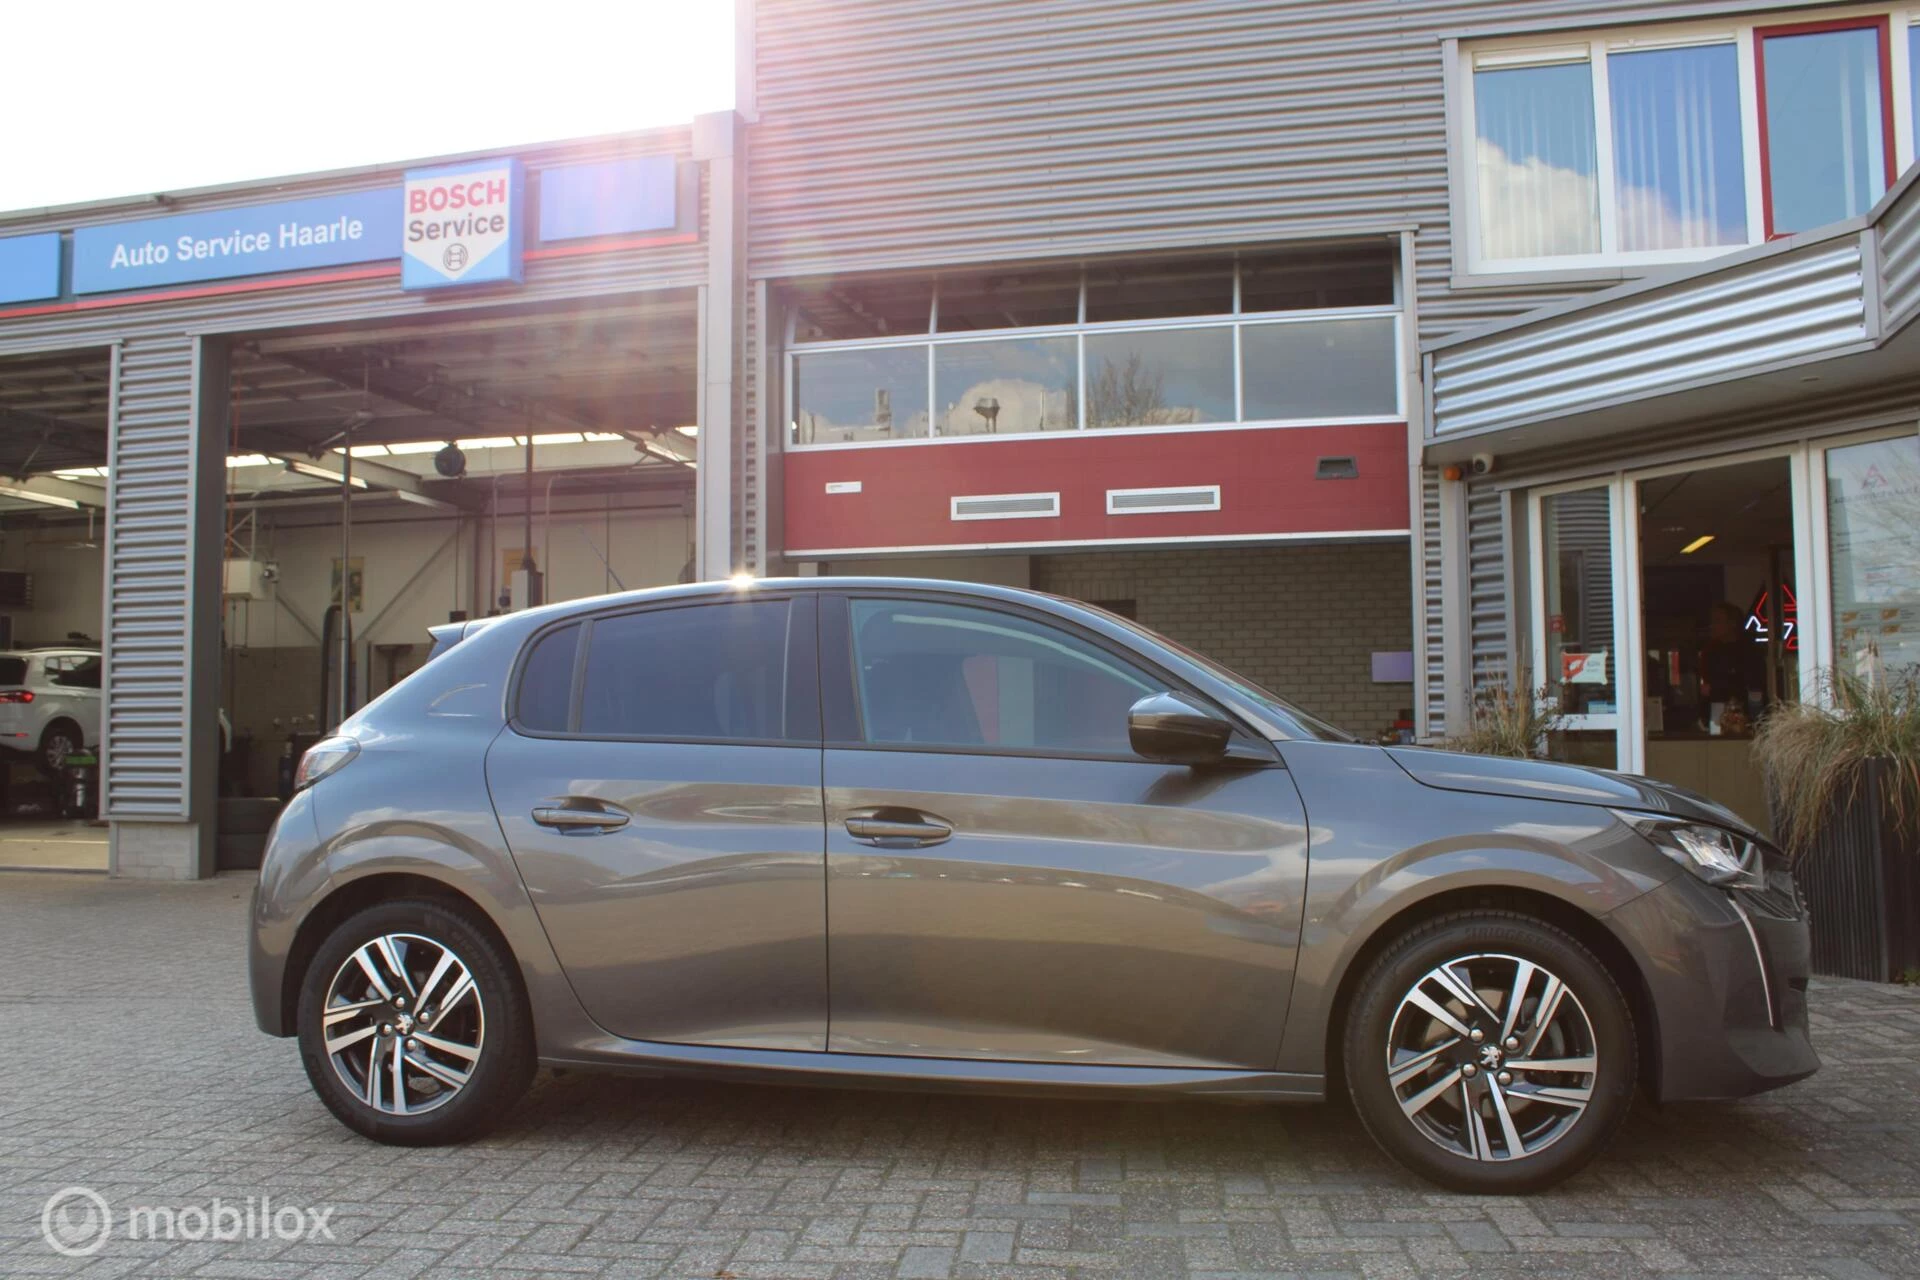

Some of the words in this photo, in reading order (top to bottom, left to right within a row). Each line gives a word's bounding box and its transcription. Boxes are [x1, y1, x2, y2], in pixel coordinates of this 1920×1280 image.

[409, 179, 506, 214] BOSCH
[110, 240, 170, 270] Auto
[176, 230, 271, 262] Service
[279, 215, 364, 249] Haarle
[407, 213, 505, 243] Service
